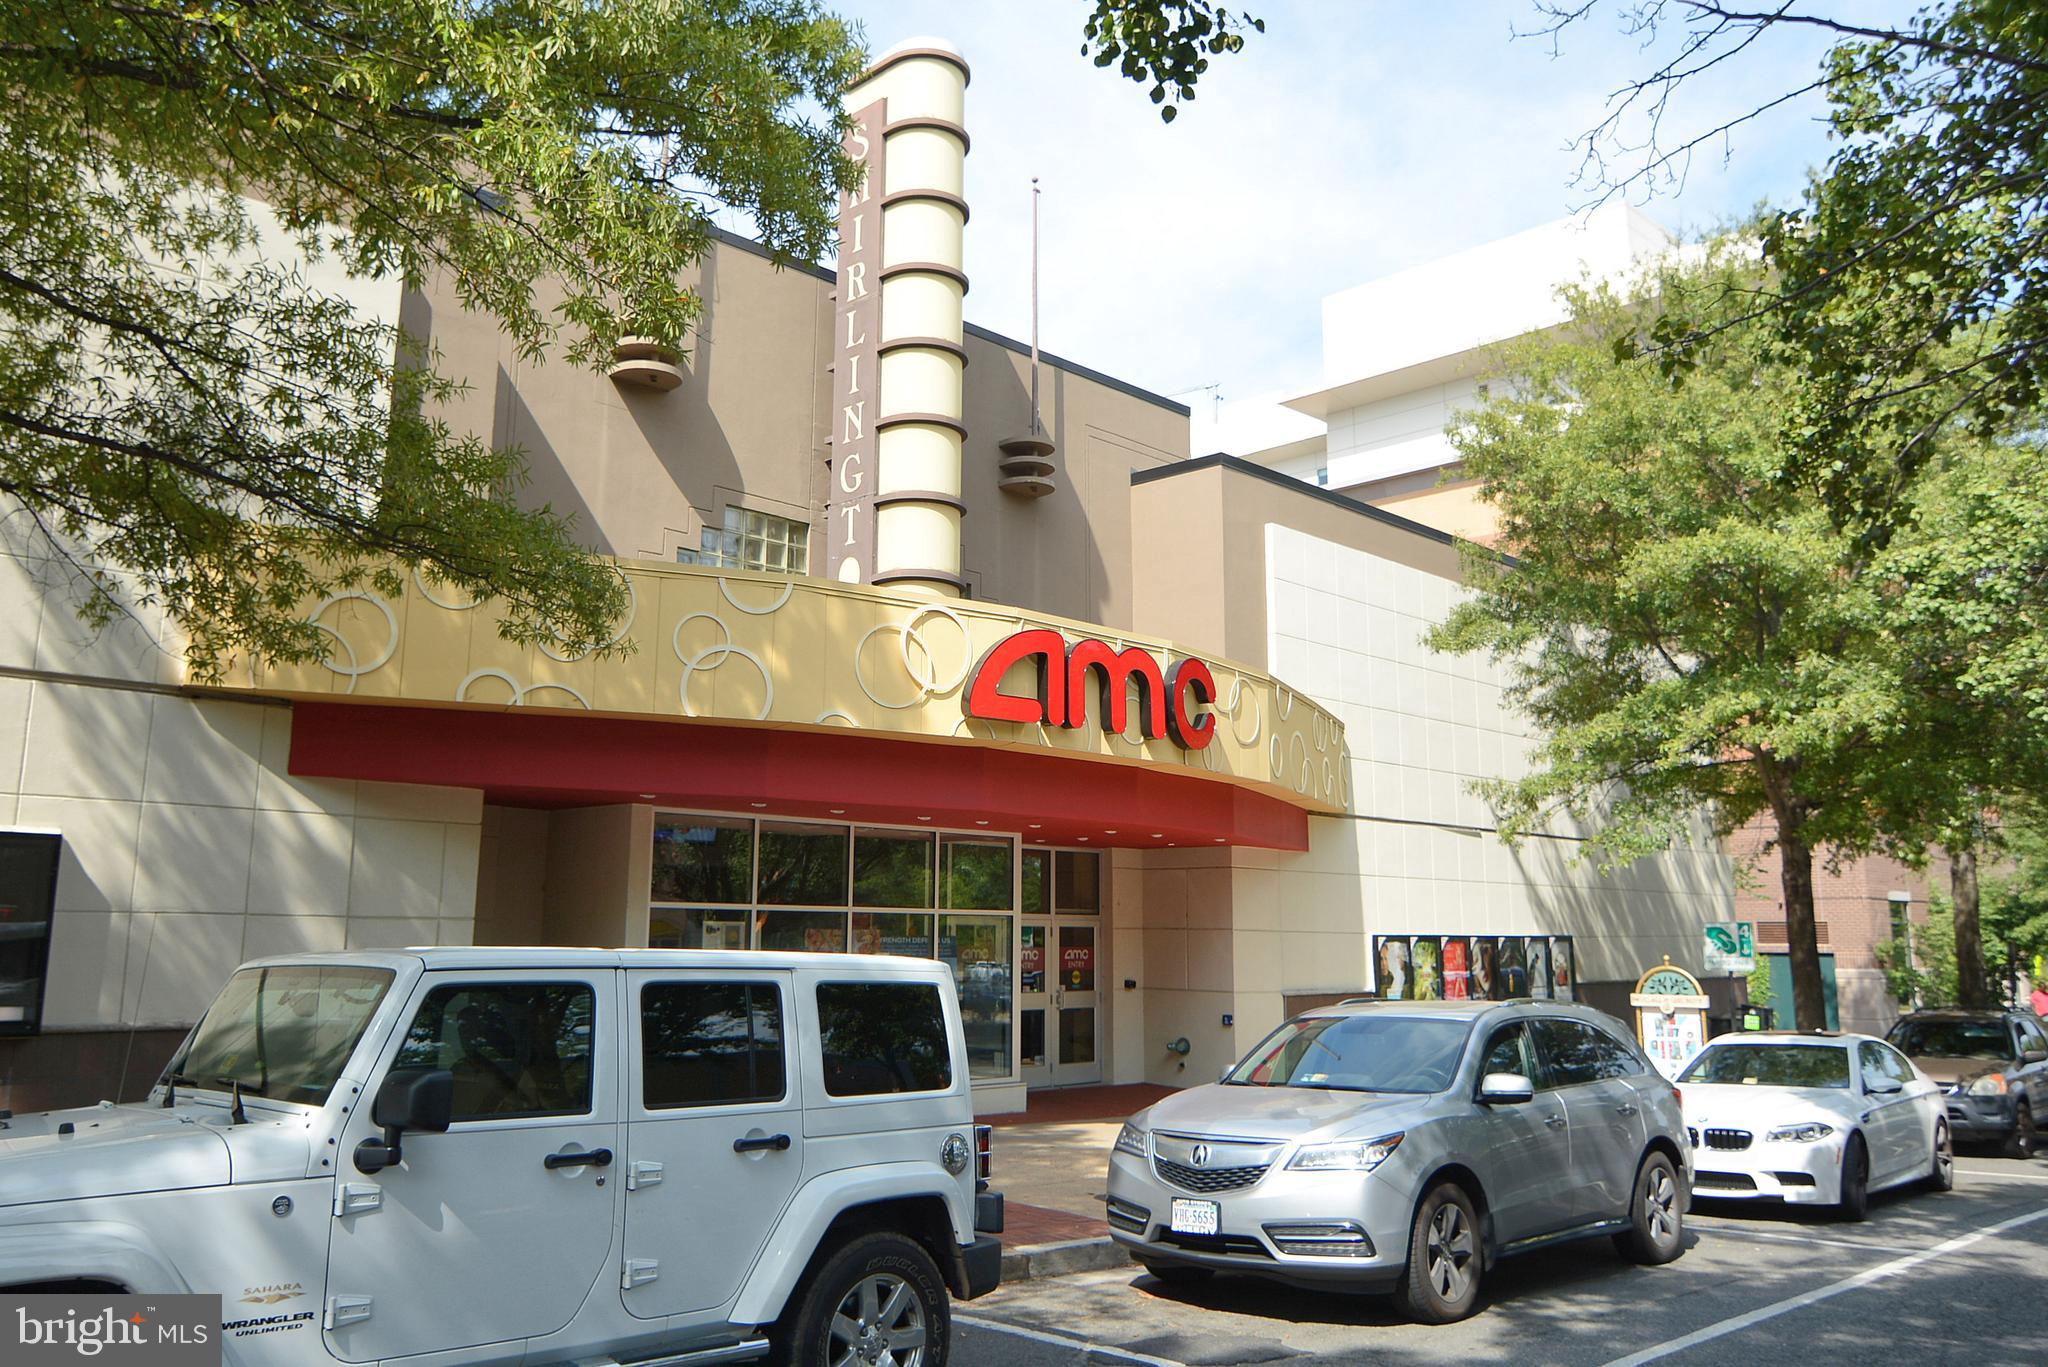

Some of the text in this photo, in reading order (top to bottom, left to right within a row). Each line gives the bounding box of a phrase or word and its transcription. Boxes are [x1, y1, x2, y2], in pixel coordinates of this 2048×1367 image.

[880, 936, 911, 944] TRENGTH
[1021, 950, 1040, 960] mc
[243, 1281, 303, 1296] SAHARA
[222, 1310, 316, 1331] WRANGLER
[235, 1322, 304, 1337] UNLIMITED
